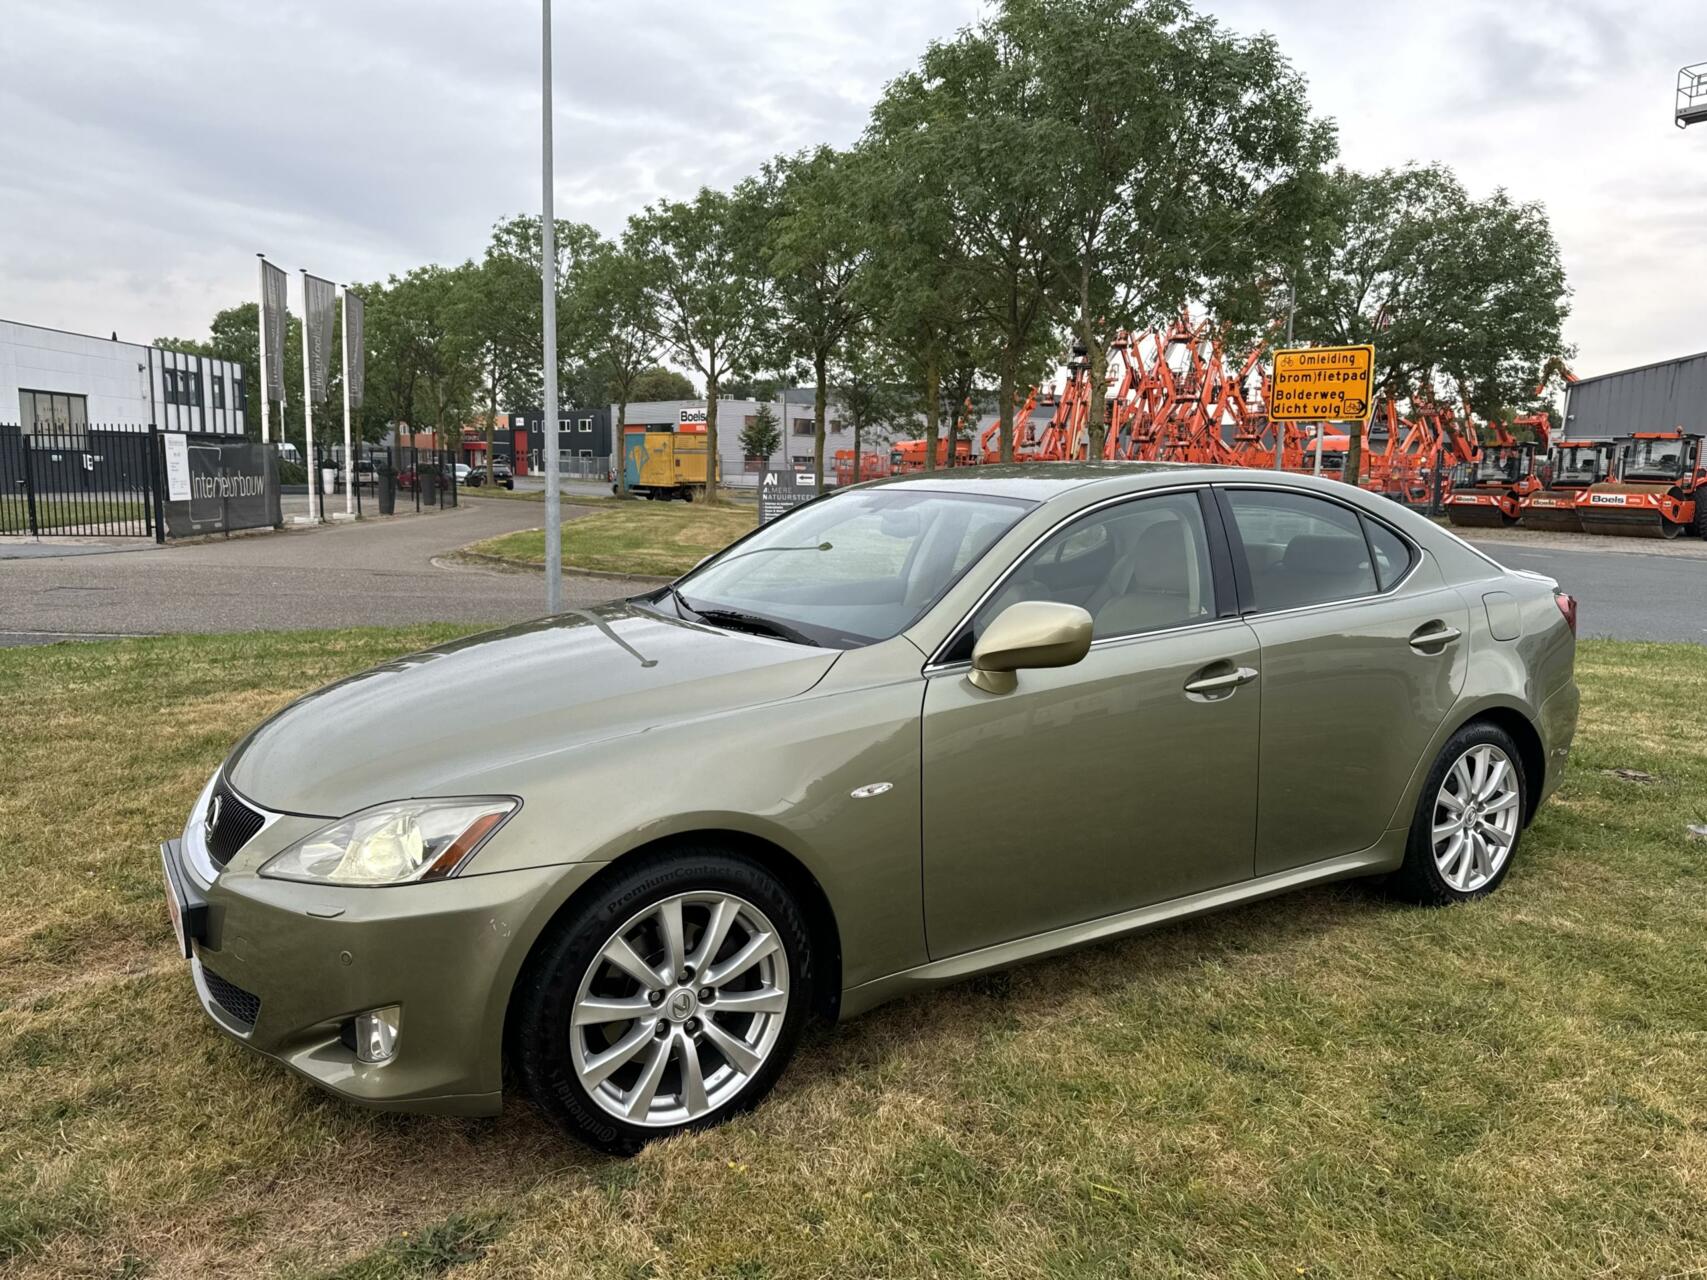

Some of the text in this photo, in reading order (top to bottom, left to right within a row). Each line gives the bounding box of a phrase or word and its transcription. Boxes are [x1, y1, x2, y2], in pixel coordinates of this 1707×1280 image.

[1299, 353, 1355, 366] Omleiding
[1274, 370, 1367, 384] (brom)fietpad
[1276, 389, 1345, 401] Bolderweg
[680, 410, 706, 422] Boels
[1273, 403, 1341, 418] dicht volg
[1591, 495, 1625, 504] Boels
[606, 864, 731, 915] PremiumContact
